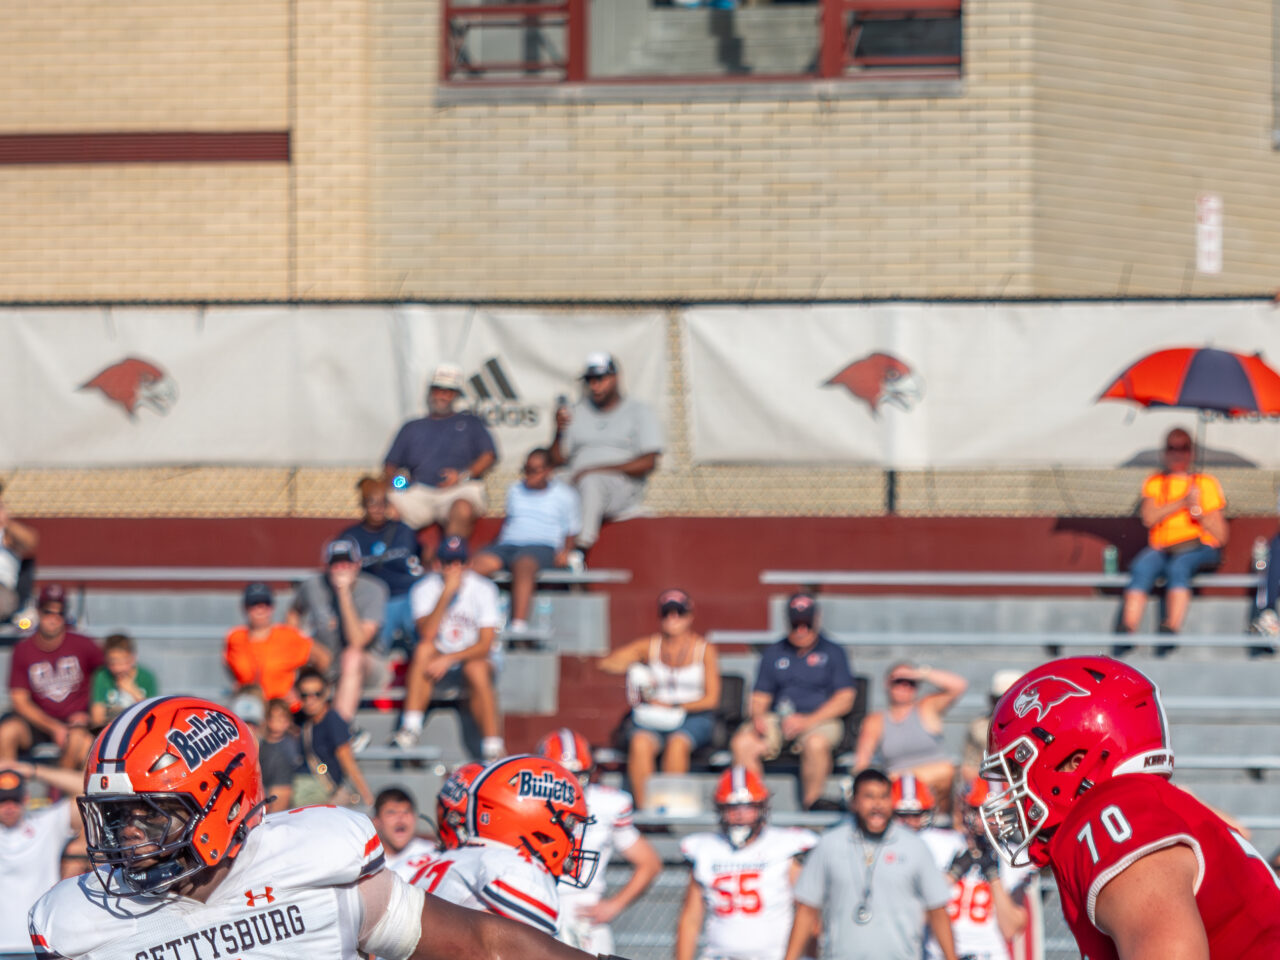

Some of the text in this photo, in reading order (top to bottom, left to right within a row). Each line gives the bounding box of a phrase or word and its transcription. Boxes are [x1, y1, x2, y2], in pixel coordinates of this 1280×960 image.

[166, 711, 239, 773] Bullets
[1143, 754, 1167, 768] KEEP
[100, 776, 109, 790] G
[518, 770, 577, 807] Bullets
[1077, 804, 1133, 865] 70
[711, 871, 763, 916] 55
